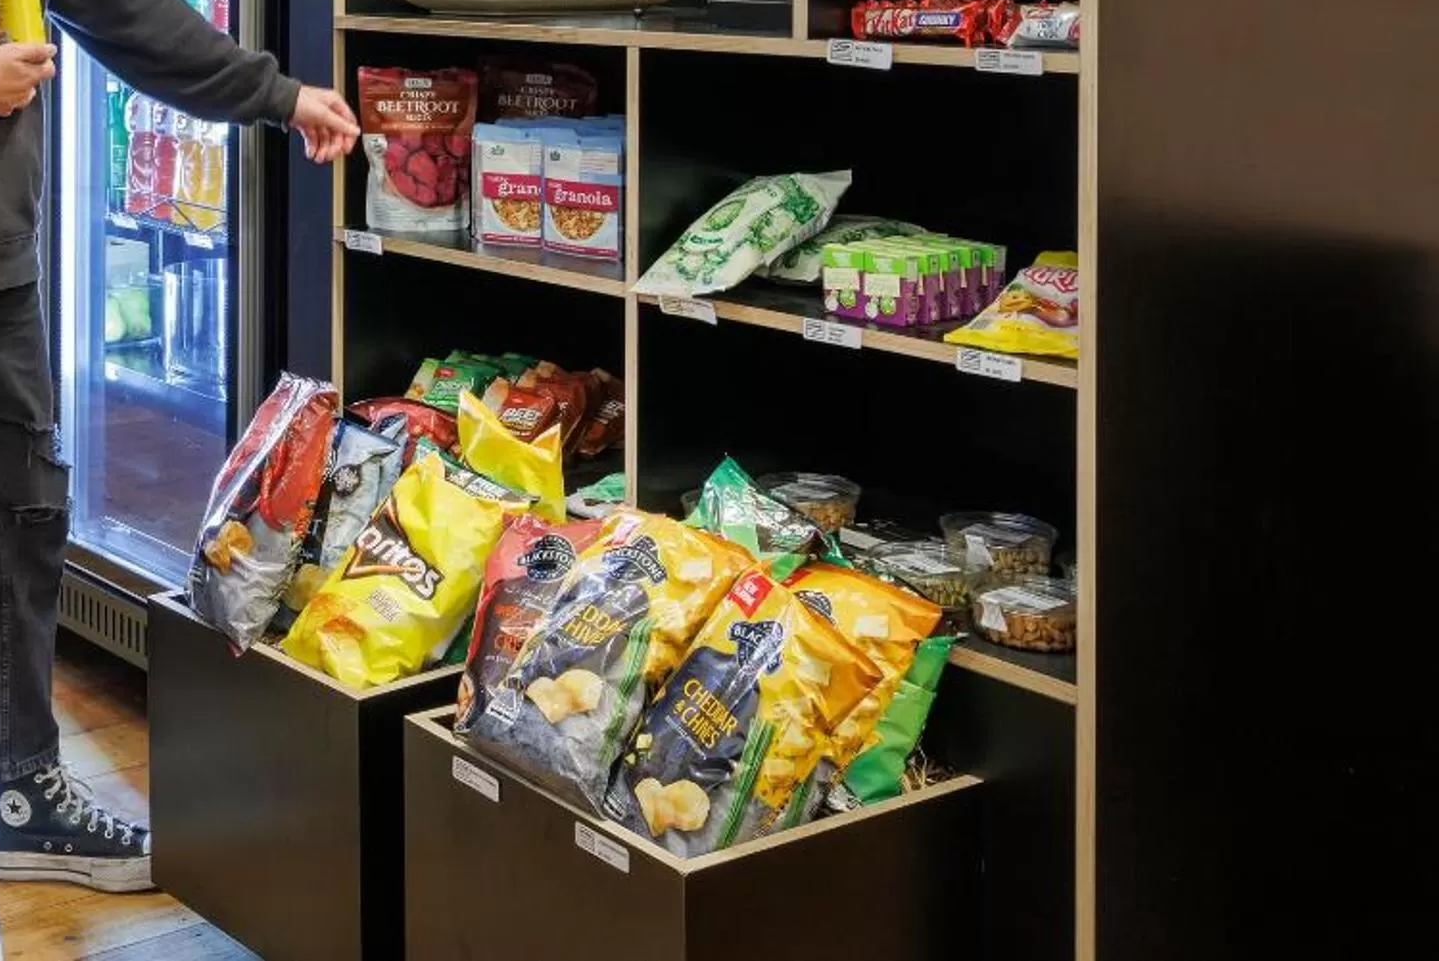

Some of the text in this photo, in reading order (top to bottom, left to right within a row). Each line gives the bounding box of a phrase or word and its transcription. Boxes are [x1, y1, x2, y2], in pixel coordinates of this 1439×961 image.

[376, 100, 460, 114] BEETROOT
[498, 95, 578, 112] BEETROOT
[498, 180, 542, 198] gran
[554, 187, 613, 207] granola
[520, 548, 575, 567] BLACKSTO
